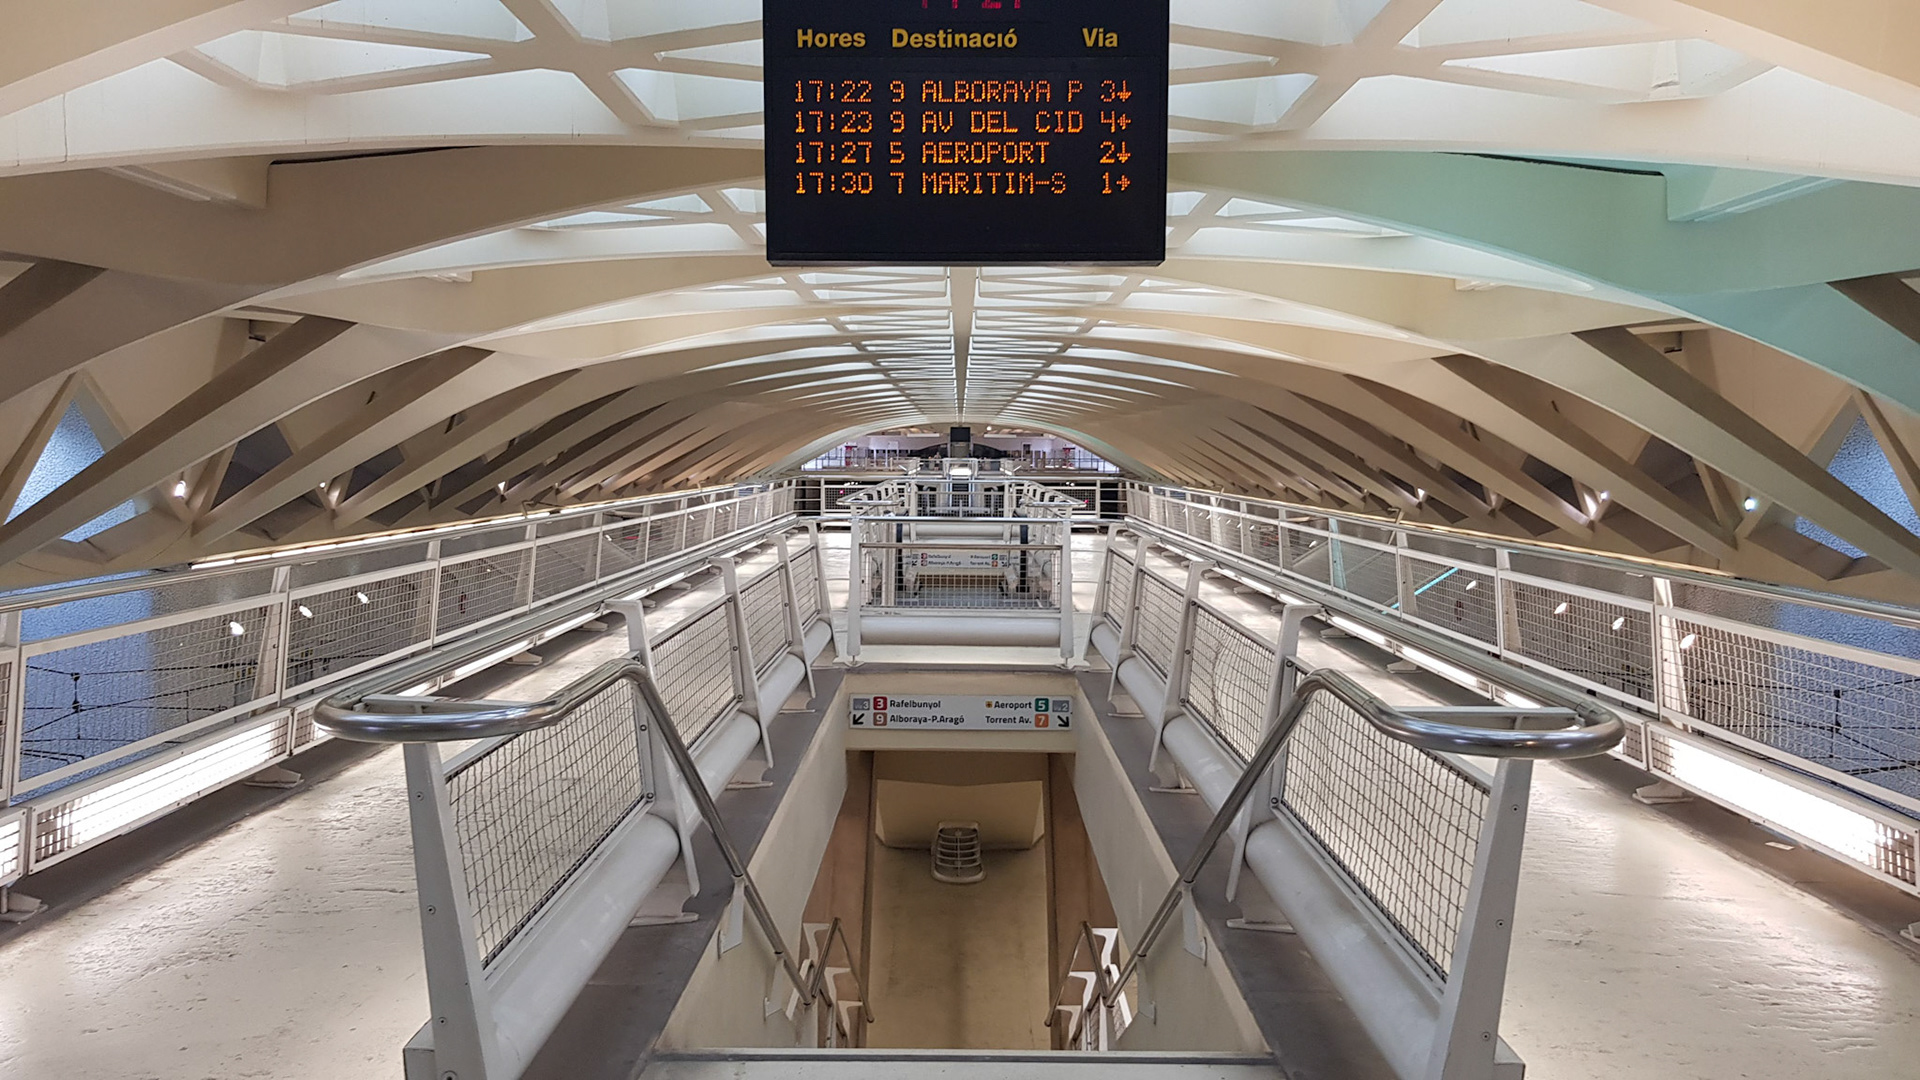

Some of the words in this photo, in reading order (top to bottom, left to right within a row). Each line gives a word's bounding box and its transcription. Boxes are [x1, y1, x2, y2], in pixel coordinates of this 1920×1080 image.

[797, 28, 866, 48] Hores
[892, 28, 1018, 48] Destinació
[1082, 28, 1118, 48] Via
[795, 80, 872, 102] 17:22
[890, 80, 905, 102] 9
[921, 80, 1051, 102] ALBORAYA
[1067, 80, 1083, 102] P
[1100, 80, 1116, 102] 3
[795, 111, 872, 133] 17:23
[890, 111, 905, 133] 9
[921, 111, 954, 133] AV
[970, 111, 1018, 133] DEL
[1035, 111, 1084, 133] CID
[1100, 111, 1116, 132] 4
[795, 142, 872, 164] 17:27
[890, 142, 905, 164] 5
[921, 142, 1050, 164] AEROPORT
[1100, 142, 1116, 163] 2
[795, 172, 873, 194] 17:30
[890, 172, 905, 194] 7
[921, 172, 1067, 194] MARITIM-S
[1101, 172, 1112, 194] 1
[890, 700, 941, 709] Rafelbunyol
[994, 701, 1032, 710] Aeroport
[890, 715, 965, 725] Alboraya-P.Aragó
[985, 716, 1016, 724] Torrent
[1018, 716, 1032, 724] Av.
